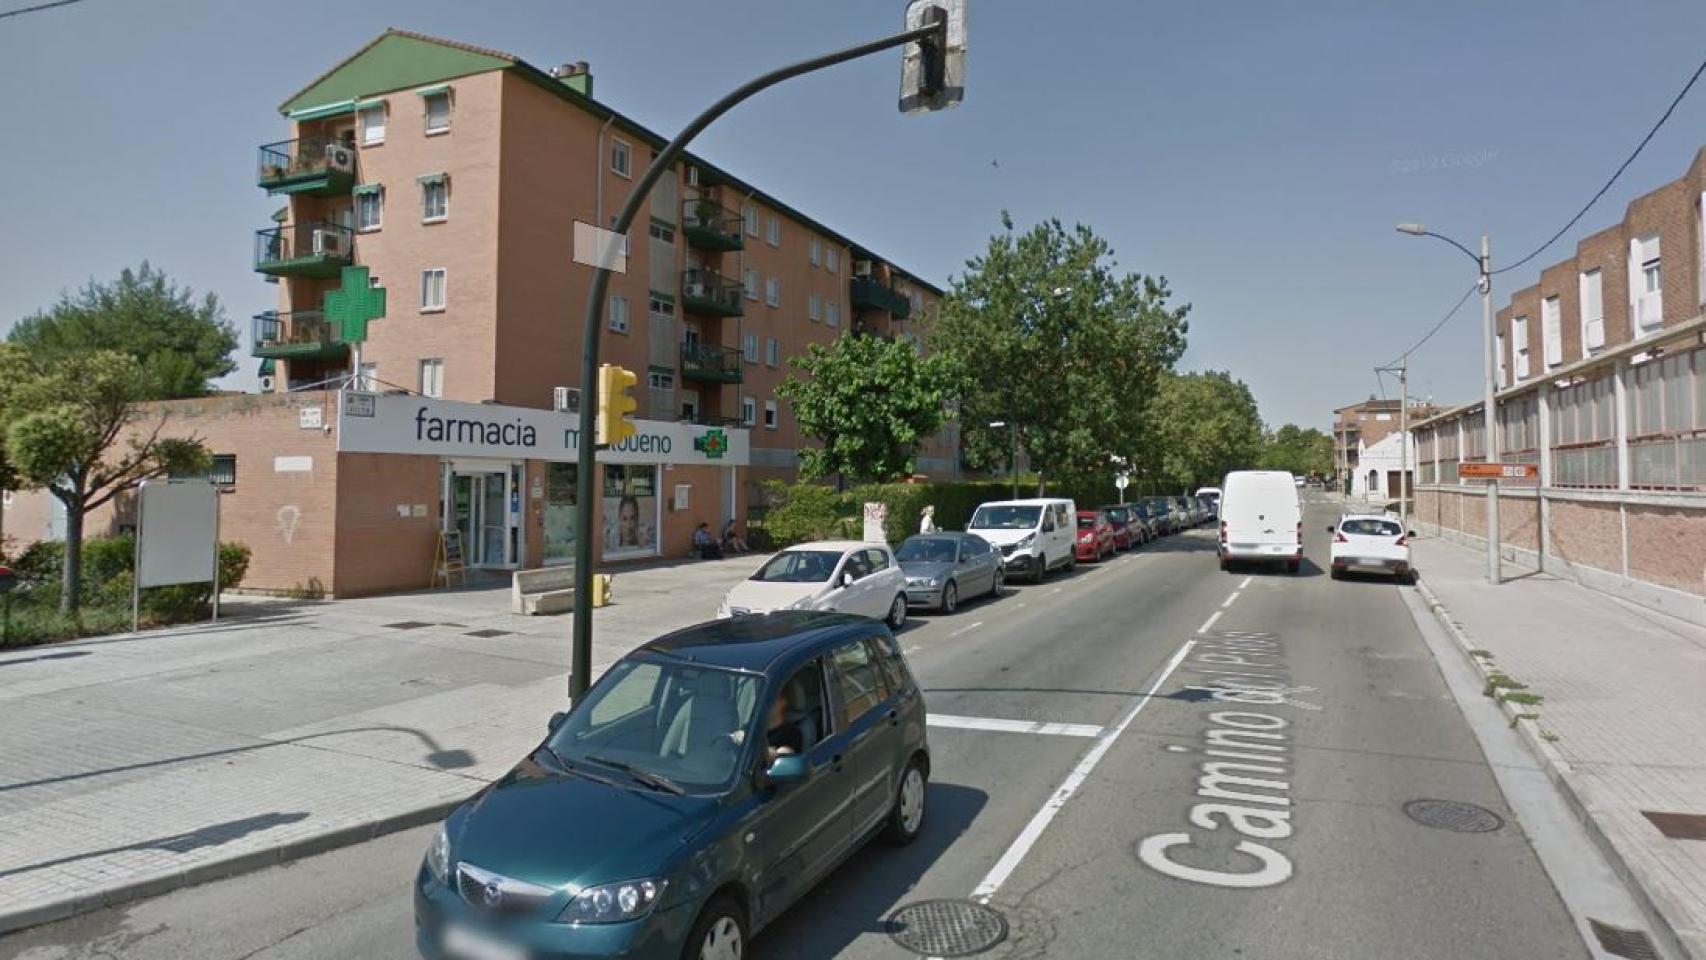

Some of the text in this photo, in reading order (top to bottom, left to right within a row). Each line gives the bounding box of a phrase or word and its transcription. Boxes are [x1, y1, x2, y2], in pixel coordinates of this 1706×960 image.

[415, 407, 672, 454] farmacia mbueno
[1137, 710, 1293, 889] Camino
